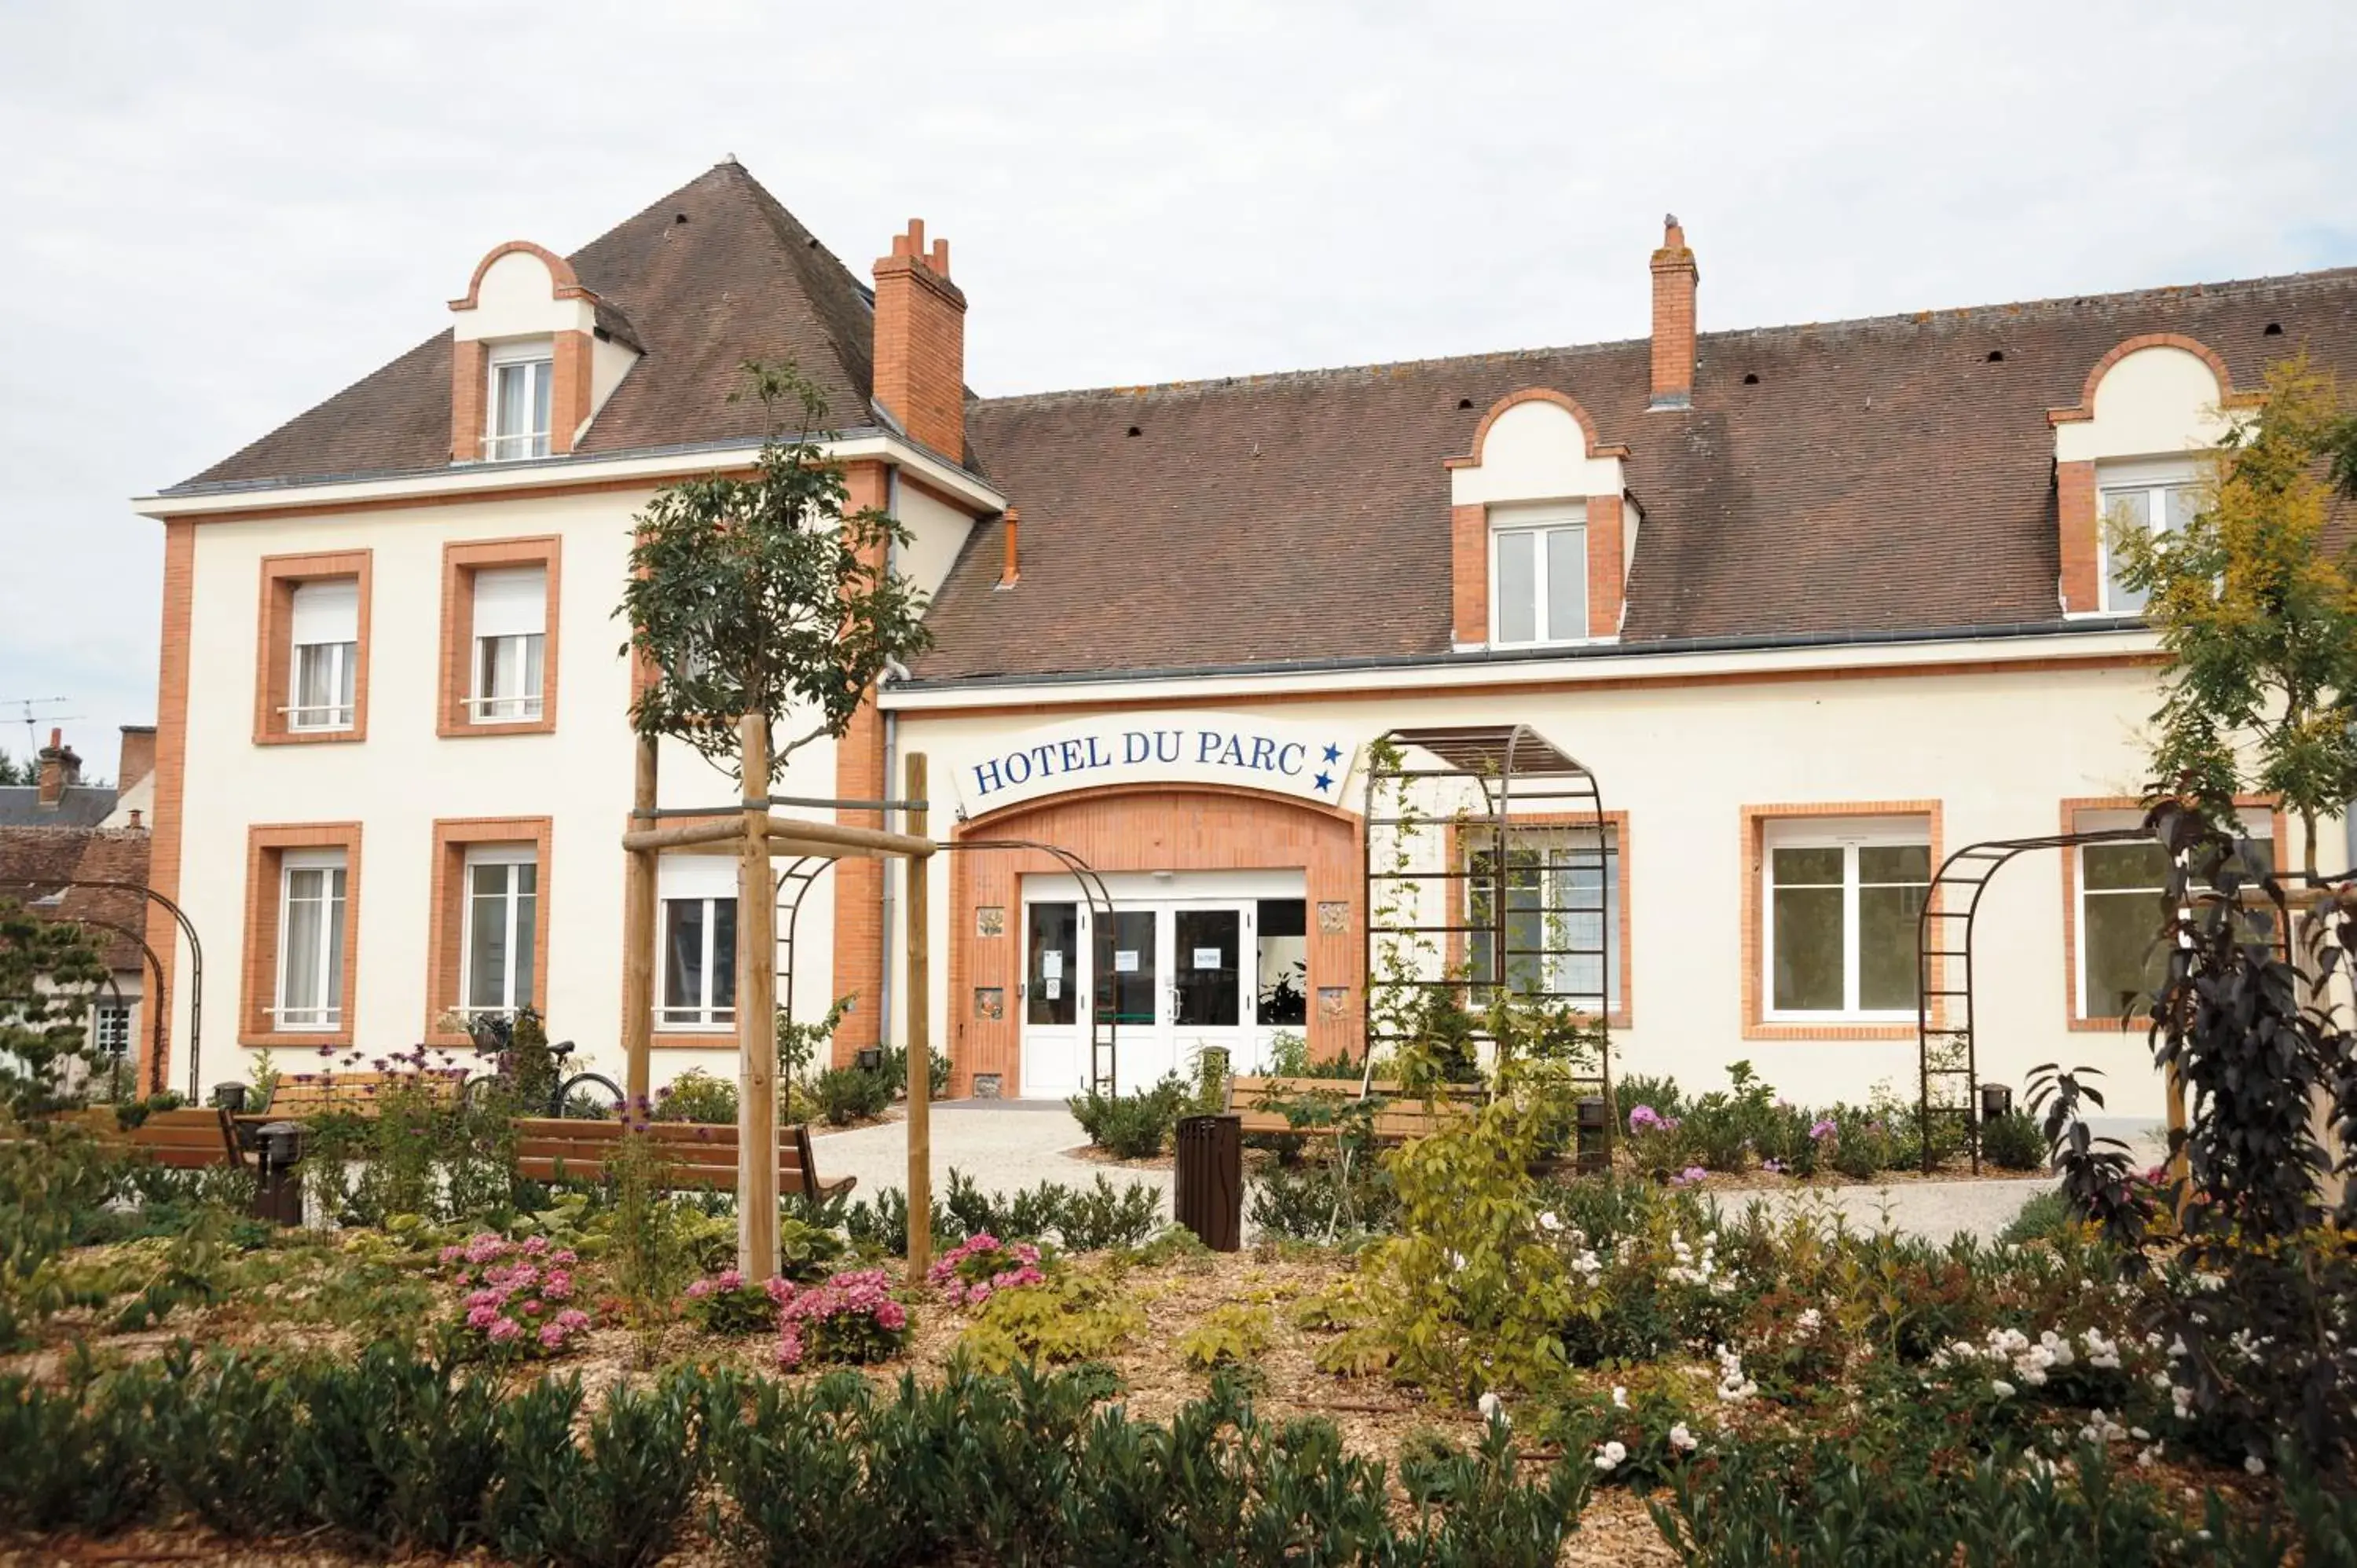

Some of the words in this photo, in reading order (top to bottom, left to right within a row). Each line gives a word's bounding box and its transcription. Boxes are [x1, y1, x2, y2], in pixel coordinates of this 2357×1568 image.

[972, 735, 1111, 796] HOTEL
[1122, 731, 1184, 764] DU
[1195, 731, 1306, 775] PARC
